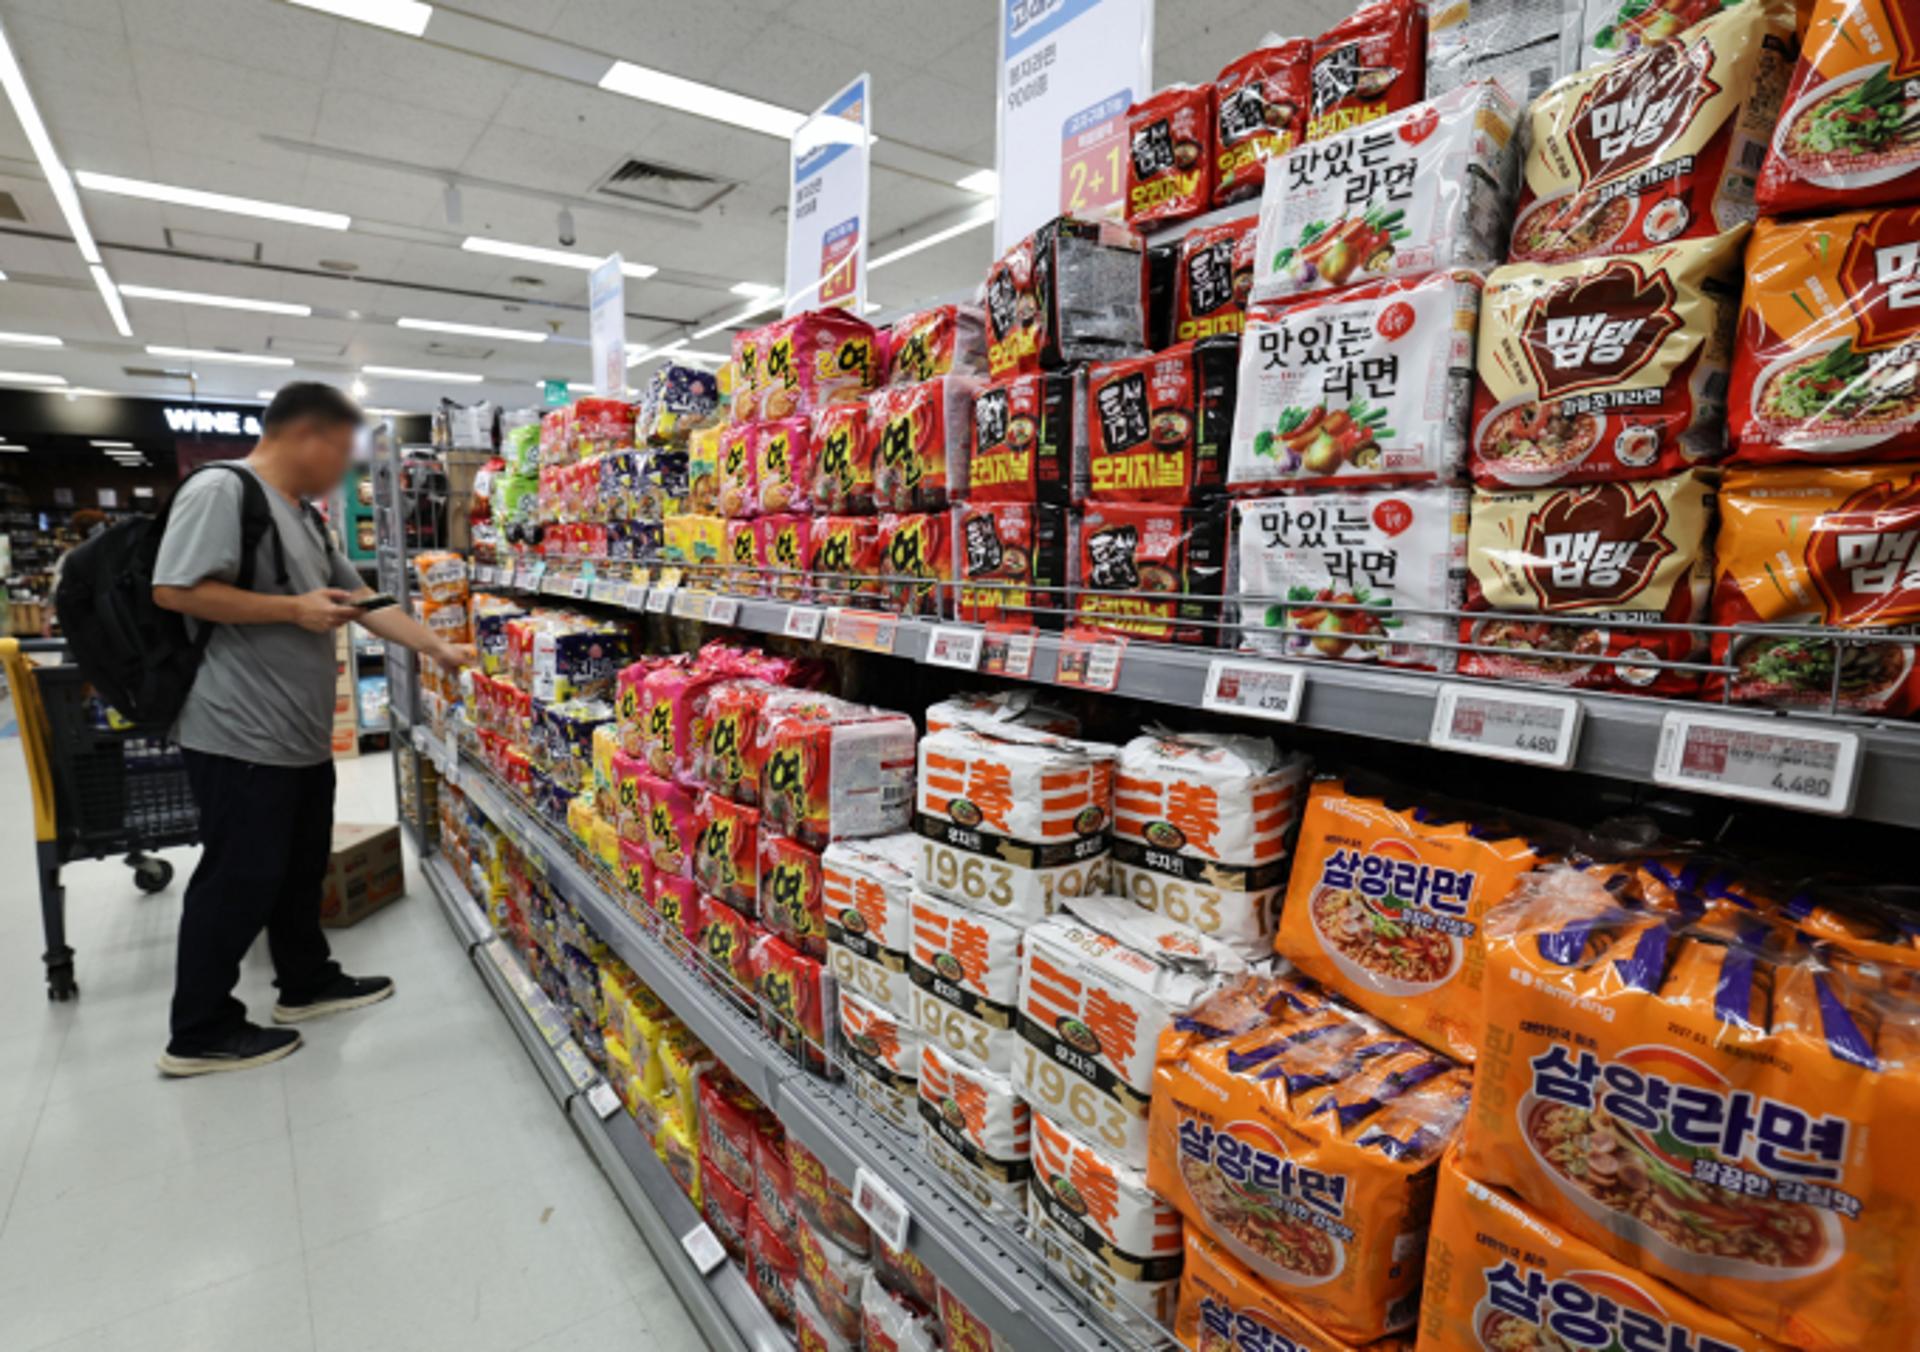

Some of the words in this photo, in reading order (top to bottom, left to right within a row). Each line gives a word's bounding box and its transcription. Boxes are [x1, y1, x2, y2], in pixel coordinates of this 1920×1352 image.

[1590, 95, 1682, 161] 맵탱
[1069, 146, 1121, 208] 2+1
[1289, 132, 1395, 191] 맛있는
[1347, 157, 1419, 207] 라면
[1259, 319, 1373, 370] 맛있는
[1546, 313, 1645, 371] 맵탱
[1322, 354, 1399, 402] 라면
[165, 408, 240, 433] WINE
[1091, 452, 1184, 491] 오리지널
[1260, 508, 1371, 549] 맛있는
[1322, 548, 1399, 589] 라면
[1543, 531, 1639, 590] 맵탱
[923, 844, 1014, 908] 1963
[1115, 865, 1222, 933] 1963
[1322, 849, 1476, 917] 삼양라면
[914, 990, 990, 1062] 1963
[1534, 979, 1617, 1023] samyang
[1023, 1046, 1128, 1149] 1963
[1530, 1043, 1850, 1184] 삼양라면
[1177, 1118, 1348, 1219] 삼양라면
[1692, 1157, 1769, 1197] 깔끔한
[1775, 1179, 1863, 1222] 감칠맛
[1483, 1260, 1743, 1352] 삼양라
